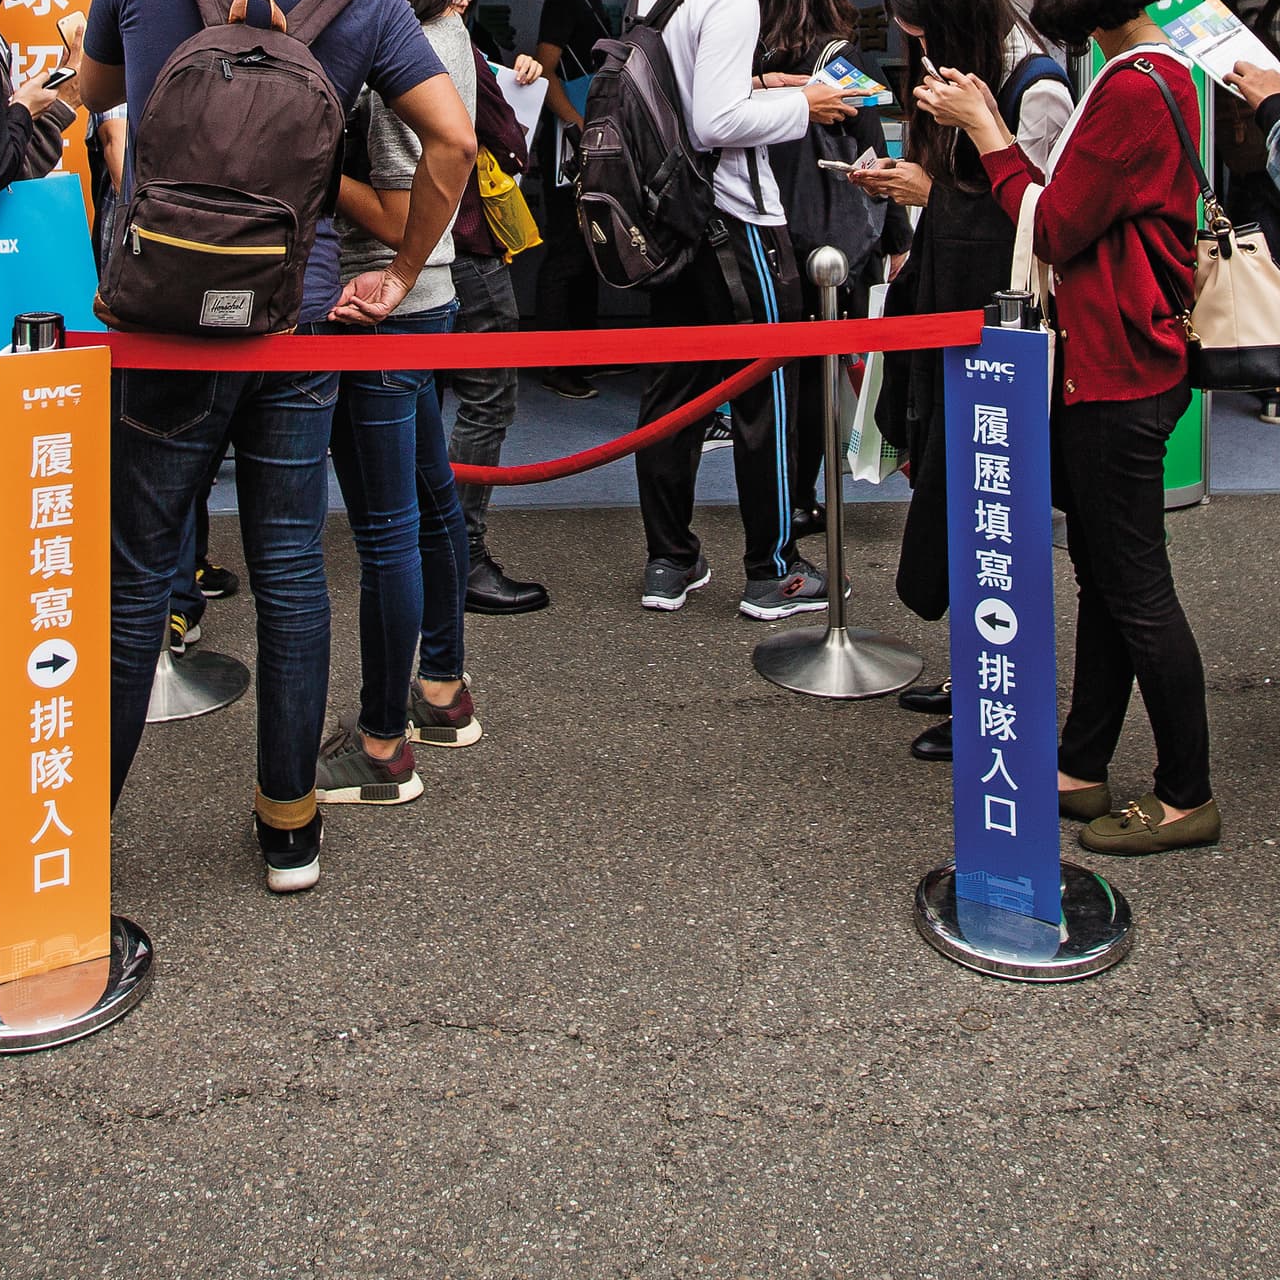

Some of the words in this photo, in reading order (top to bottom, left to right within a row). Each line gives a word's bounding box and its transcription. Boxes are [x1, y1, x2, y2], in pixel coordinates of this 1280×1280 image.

[22, 384, 82, 401] UMC
[965, 358, 1015, 375] UMC
[30, 432, 74, 632] 履歷填寫
[973, 403, 1013, 591] 履歷填寫
[30, 696, 74, 893] 排隊入口
[978, 651, 1018, 837] 排隊入口
